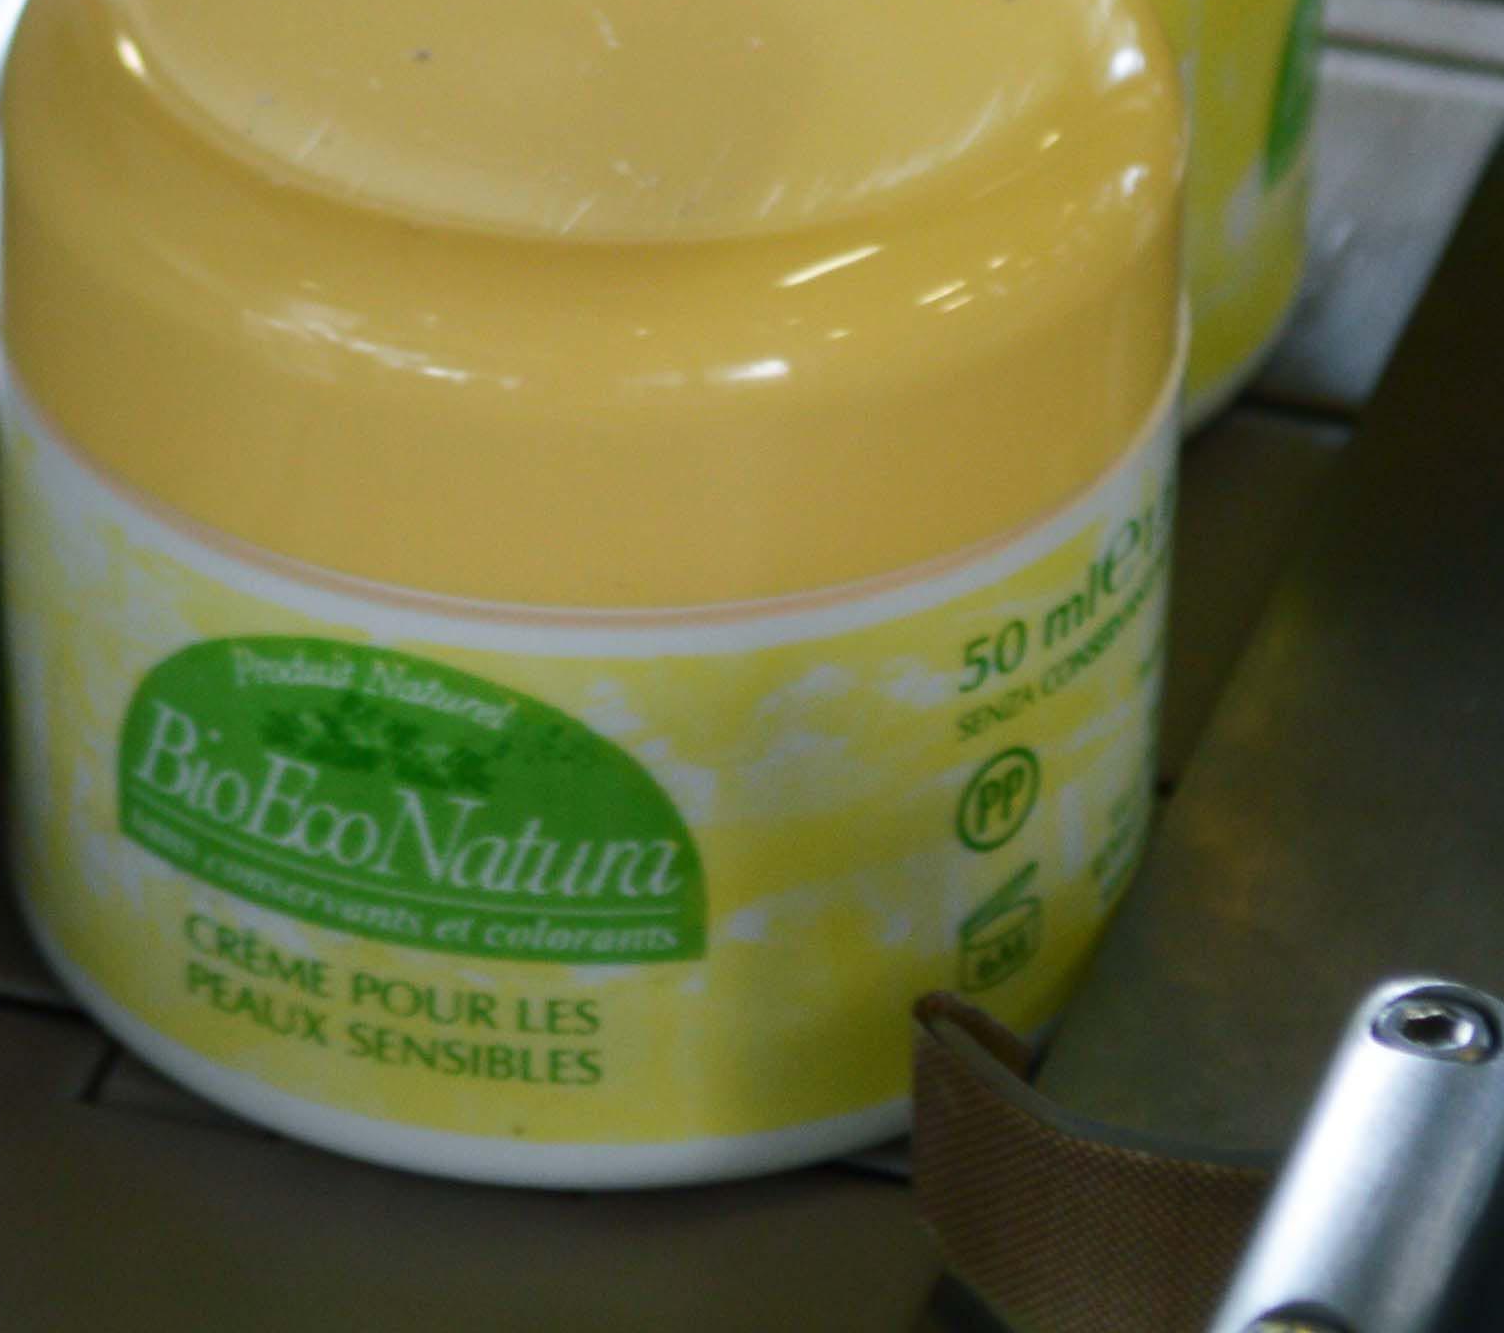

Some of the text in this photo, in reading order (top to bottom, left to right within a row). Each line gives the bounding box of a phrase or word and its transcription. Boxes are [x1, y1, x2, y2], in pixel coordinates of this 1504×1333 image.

[230, 644, 517, 730] Produit Naturel
[959, 618, 1028, 694] 50
[135, 696, 684, 898] BioEcoNatura
[436, 919, 474, 944] et
[187, 958, 604, 1087] PEAUX SENSIBLES
[350, 970, 497, 1030] POUR
[516, 995, 601, 1037] LES
